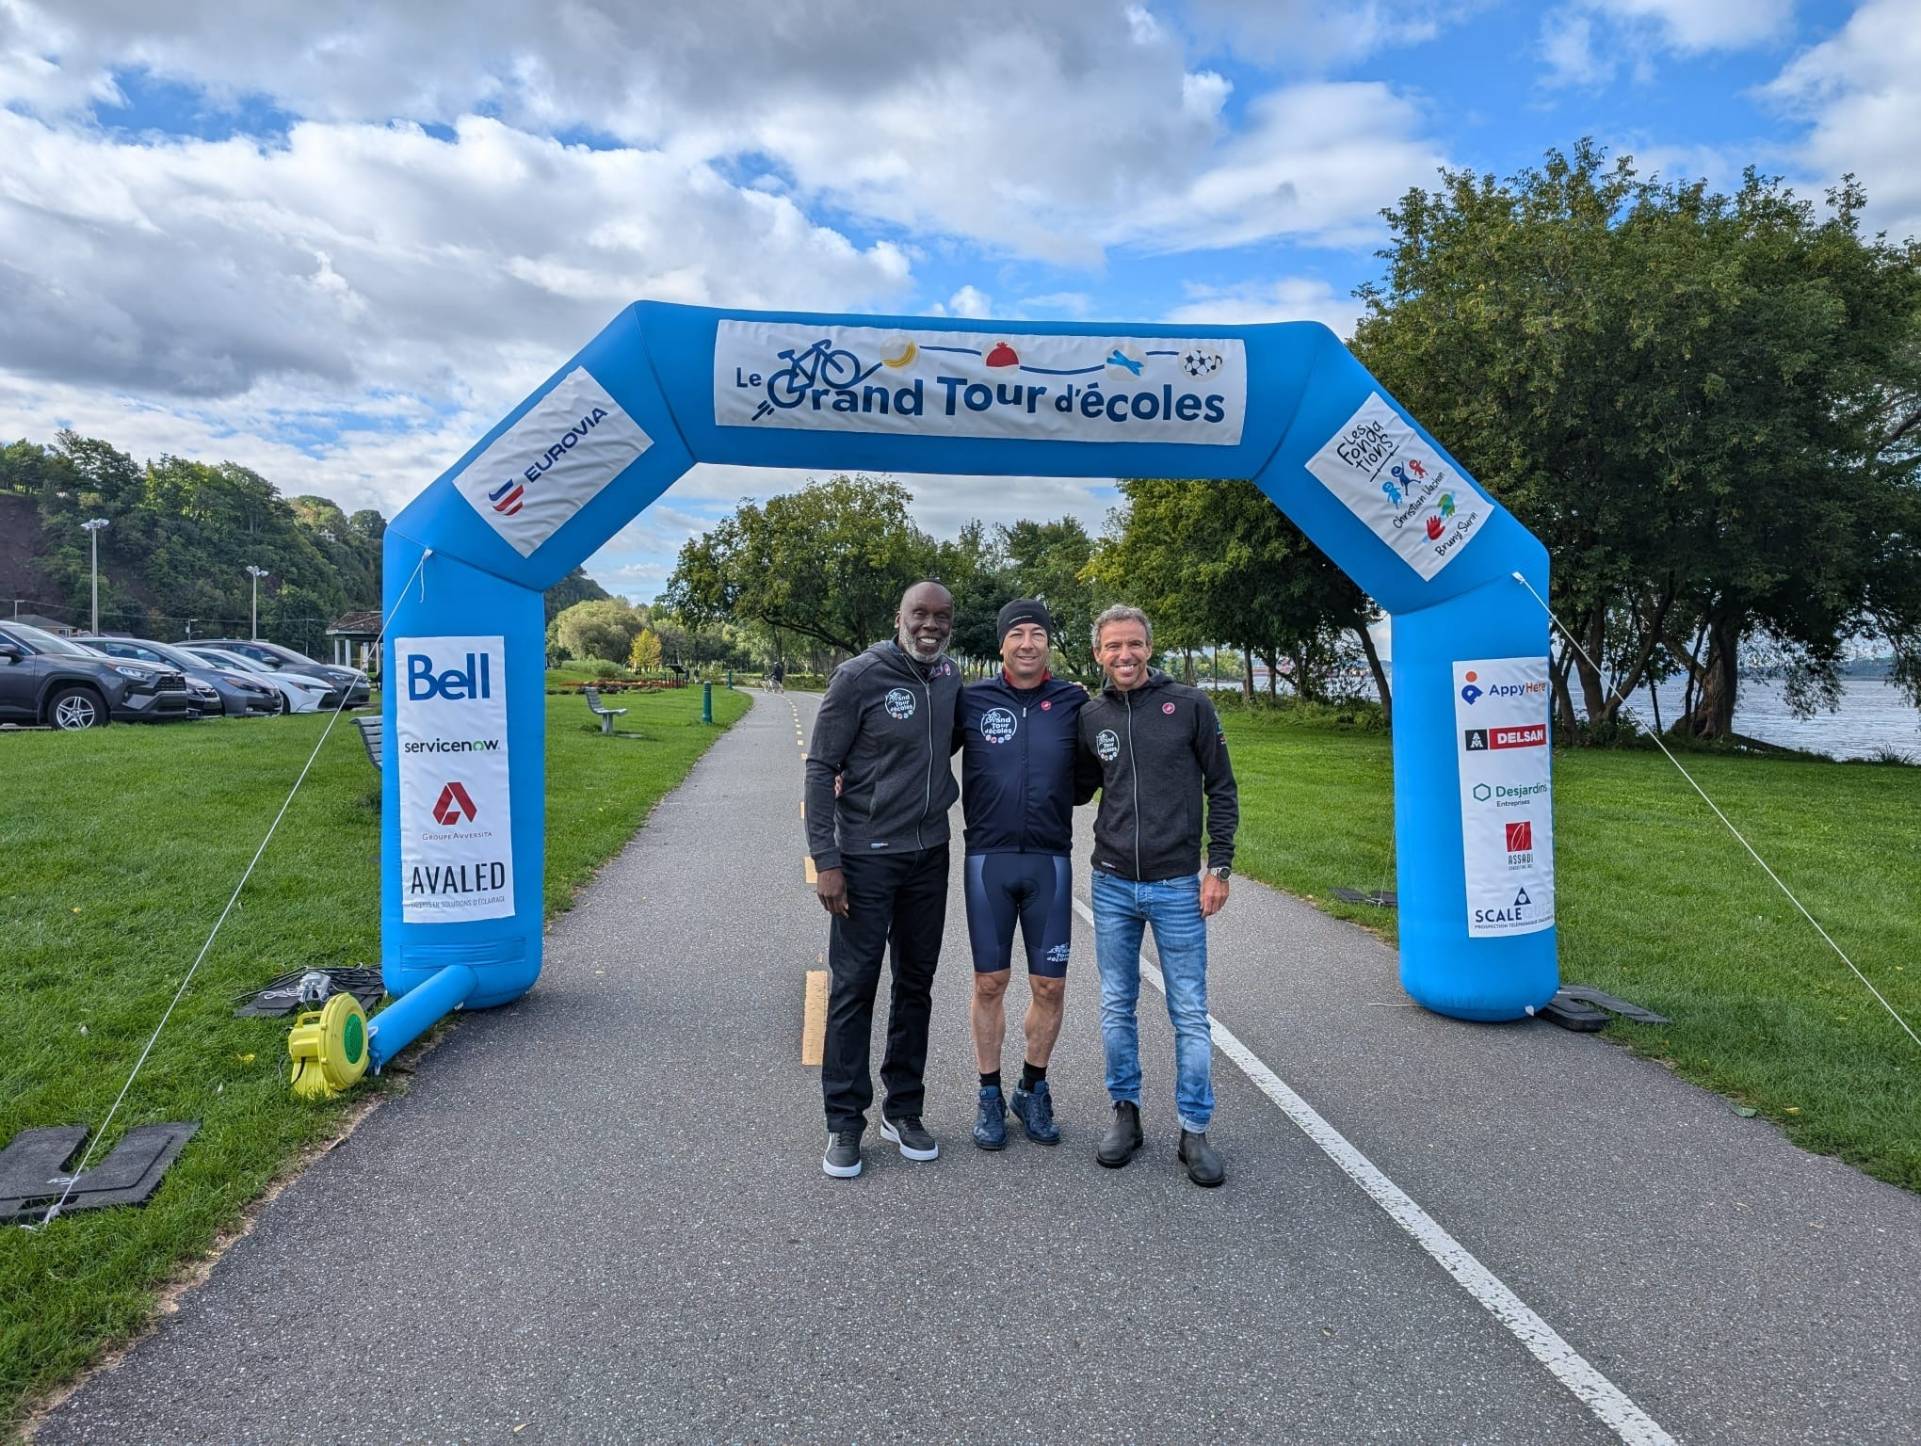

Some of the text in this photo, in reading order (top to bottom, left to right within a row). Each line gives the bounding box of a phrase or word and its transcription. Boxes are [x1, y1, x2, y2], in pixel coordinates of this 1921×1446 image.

[736, 366, 762, 388] Le
[936, 375, 1047, 417] Tour
[1054, 383, 1225, 423] d'écoles
[523, 407, 608, 483] EUROVIA
[1343, 424, 1366, 446] Les
[1393, 494, 1427, 529] Christian
[1435, 531, 1461, 557] Bruny
[407, 652, 491, 701] Bell
[404, 738, 499, 753] servicenow
[1497, 729, 1544, 745] DELSAN
[1495, 782, 1548, 798] Desjardins
[1496, 799, 1531, 808] Entreprises
[410, 861, 506, 895] AVALED
[1475, 907, 1523, 923] SCALE
